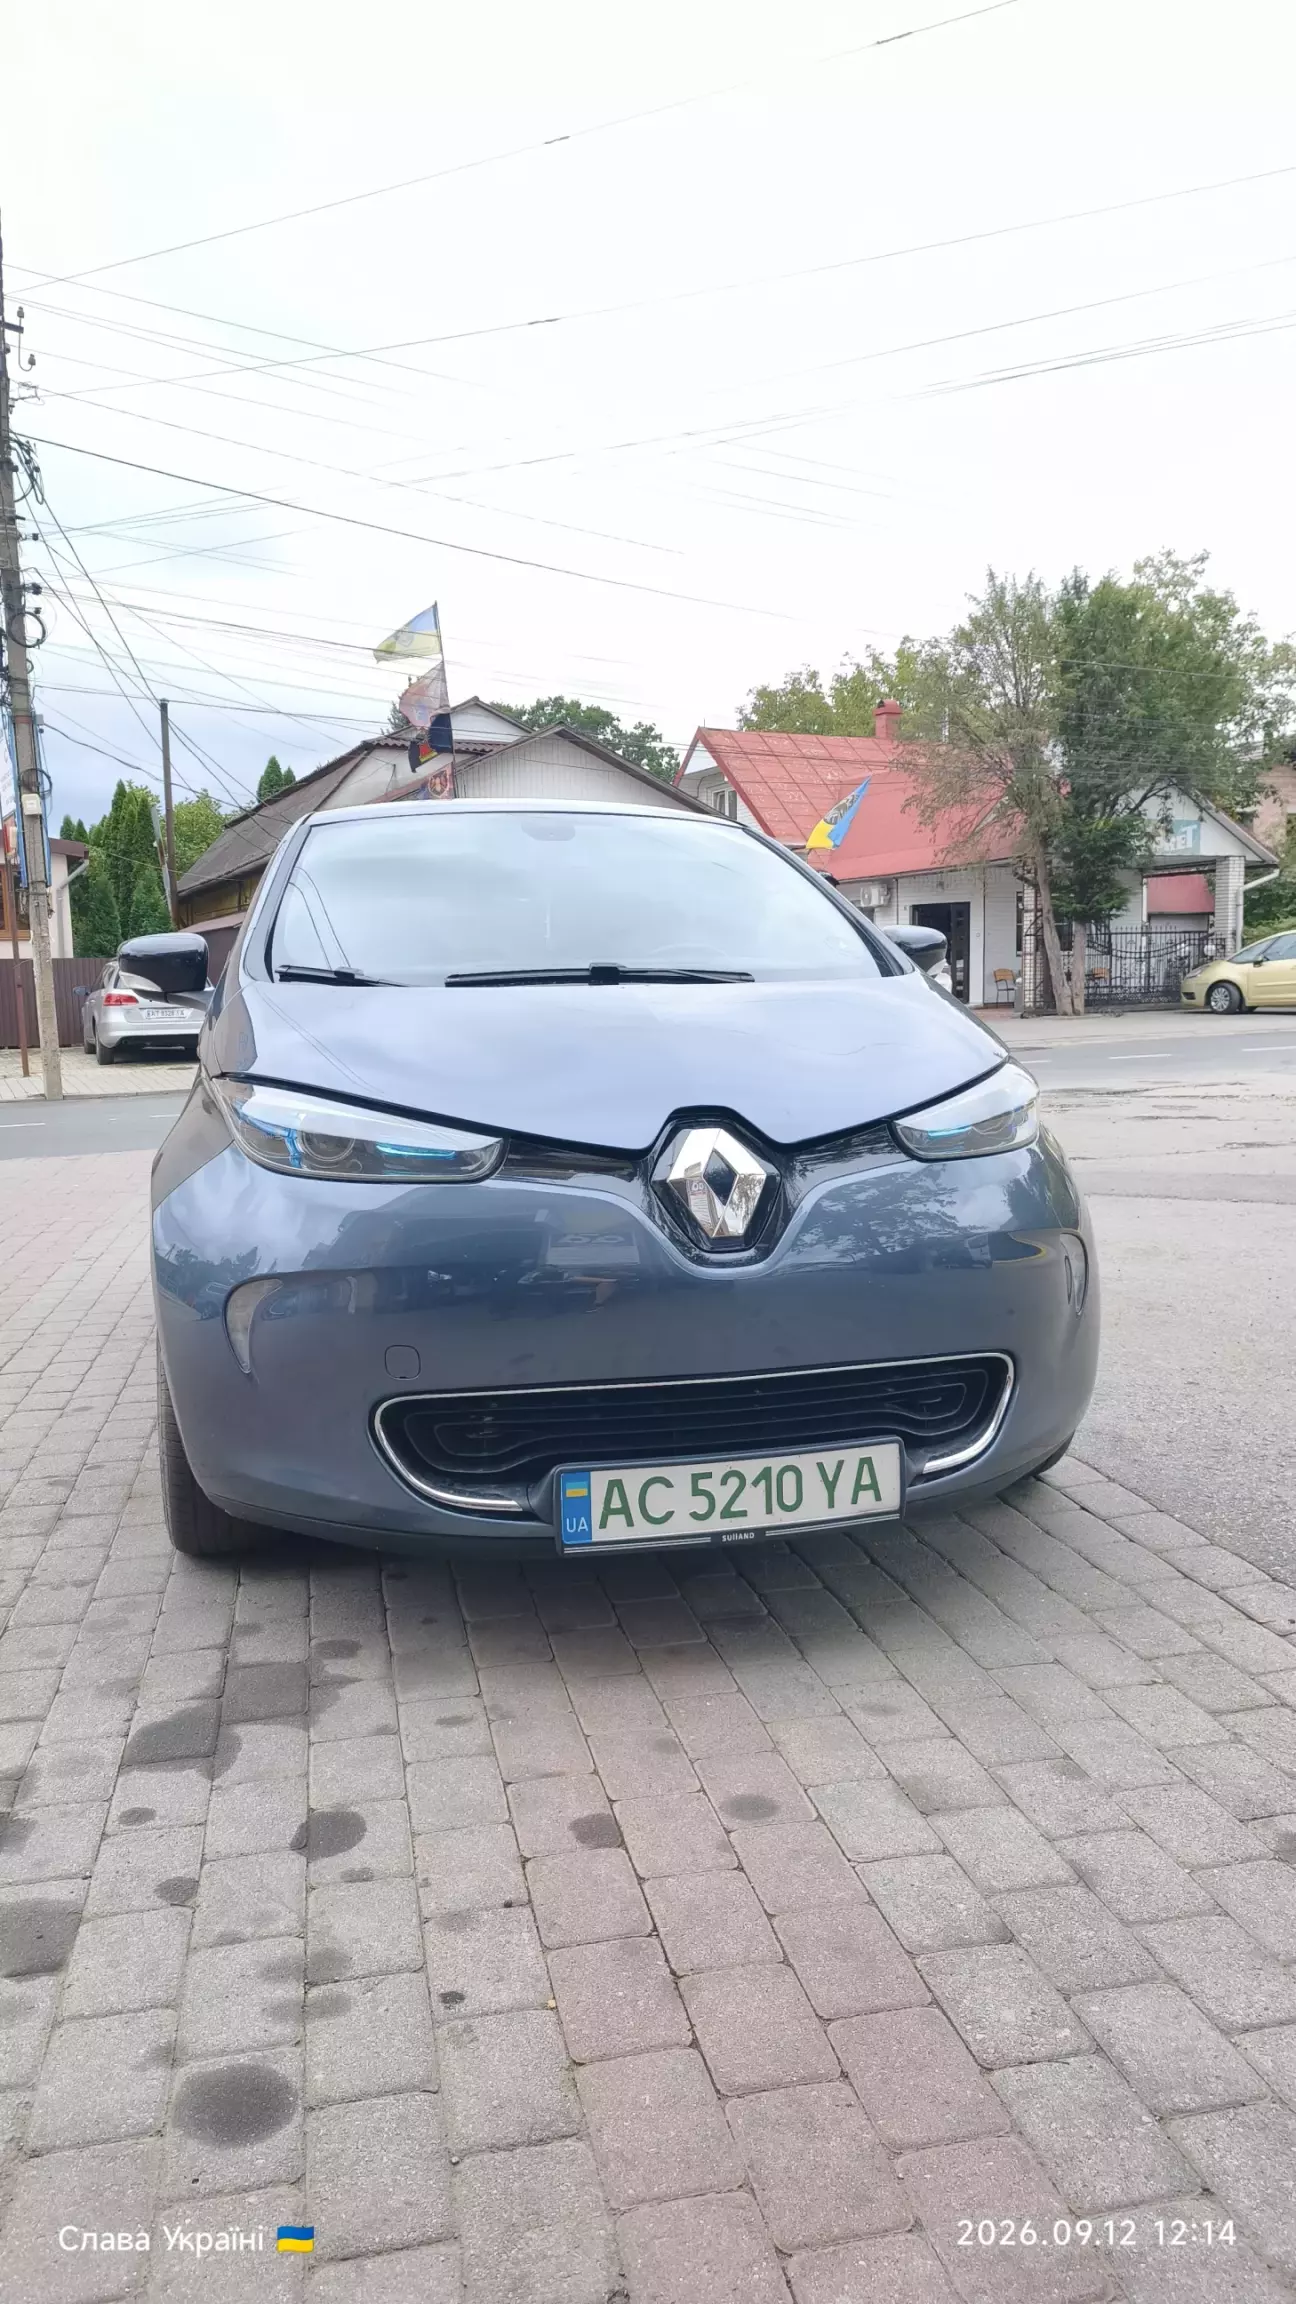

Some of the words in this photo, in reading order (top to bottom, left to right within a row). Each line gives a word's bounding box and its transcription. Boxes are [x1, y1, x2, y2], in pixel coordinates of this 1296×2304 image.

[598, 1475, 675, 1530] AC
[689, 1464, 804, 1522] 5210
[816, 1456, 883, 1510] YA
[566, 1517, 589, 1533] UA
